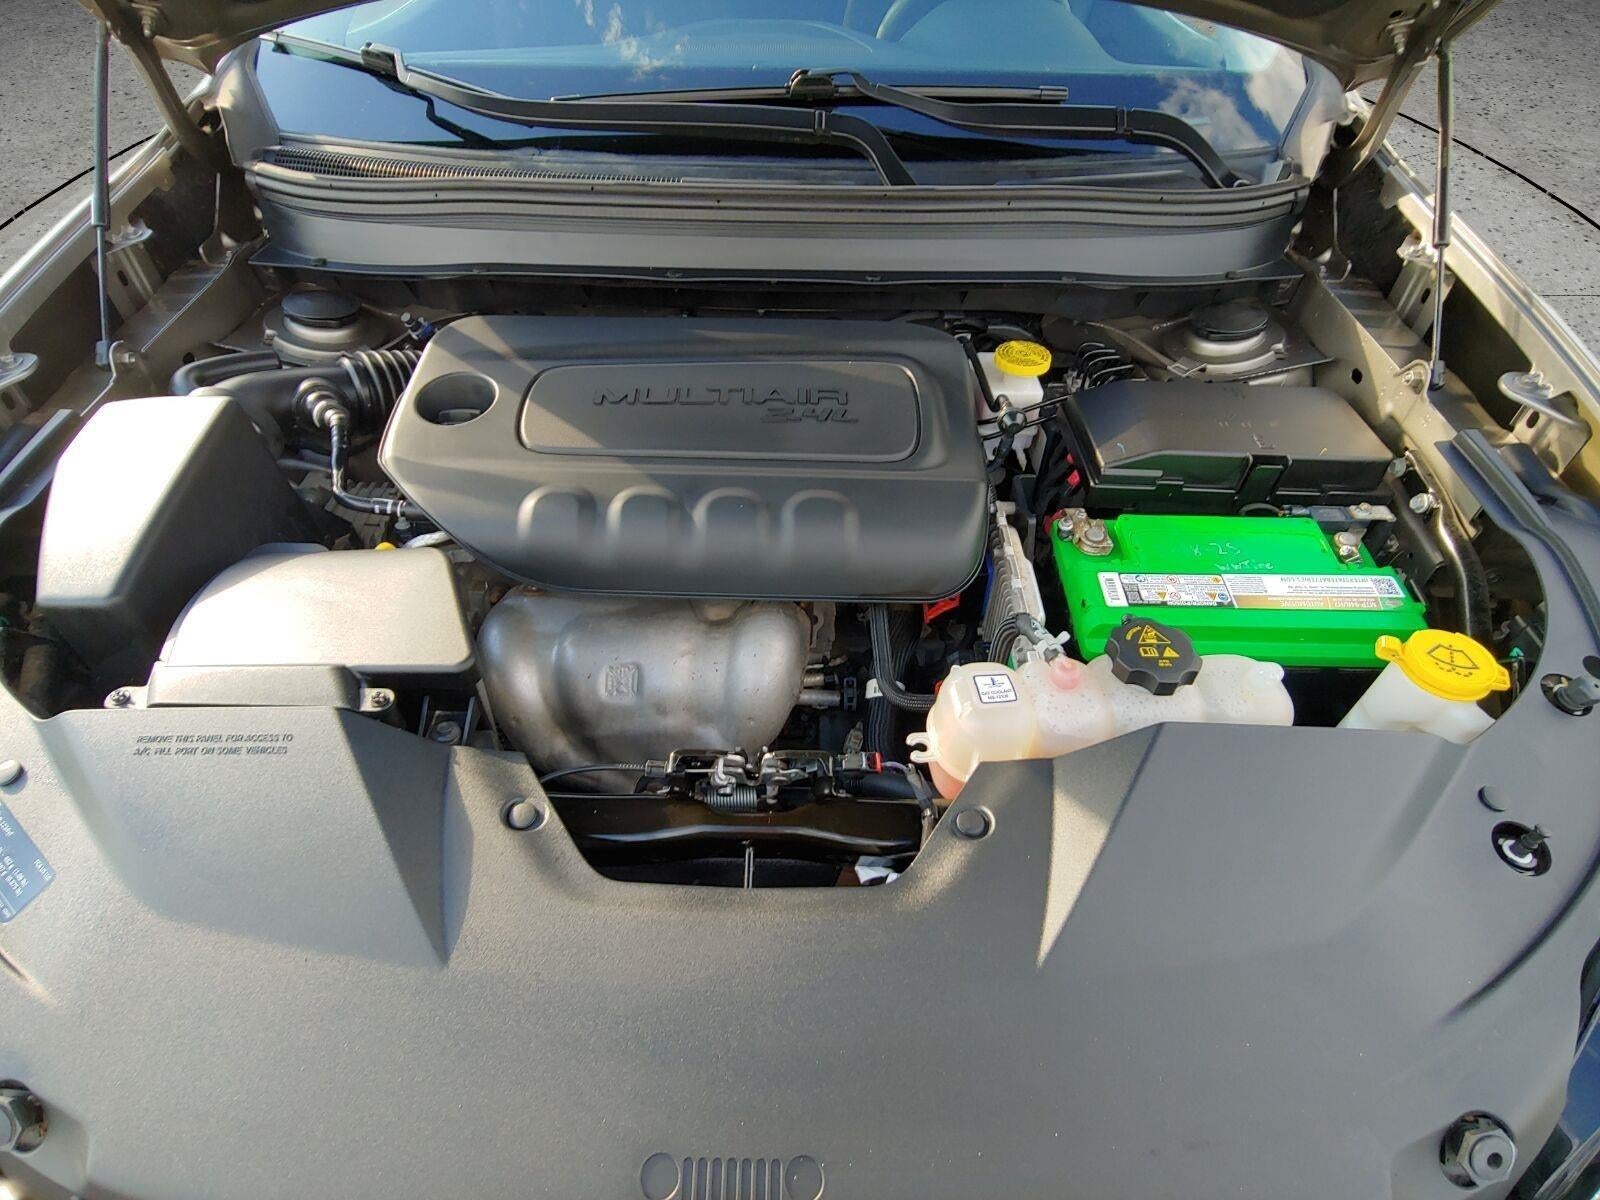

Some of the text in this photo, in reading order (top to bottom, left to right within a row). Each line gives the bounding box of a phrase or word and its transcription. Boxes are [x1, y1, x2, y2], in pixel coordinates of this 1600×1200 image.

[593, 386, 849, 406] MULTIAIR
[136, 733, 294, 743] REMOVE THIS PANEL FOR ACCESS TO
[133, 746, 288, 756] A/C FILL PORT ON SOME VEHICLES
